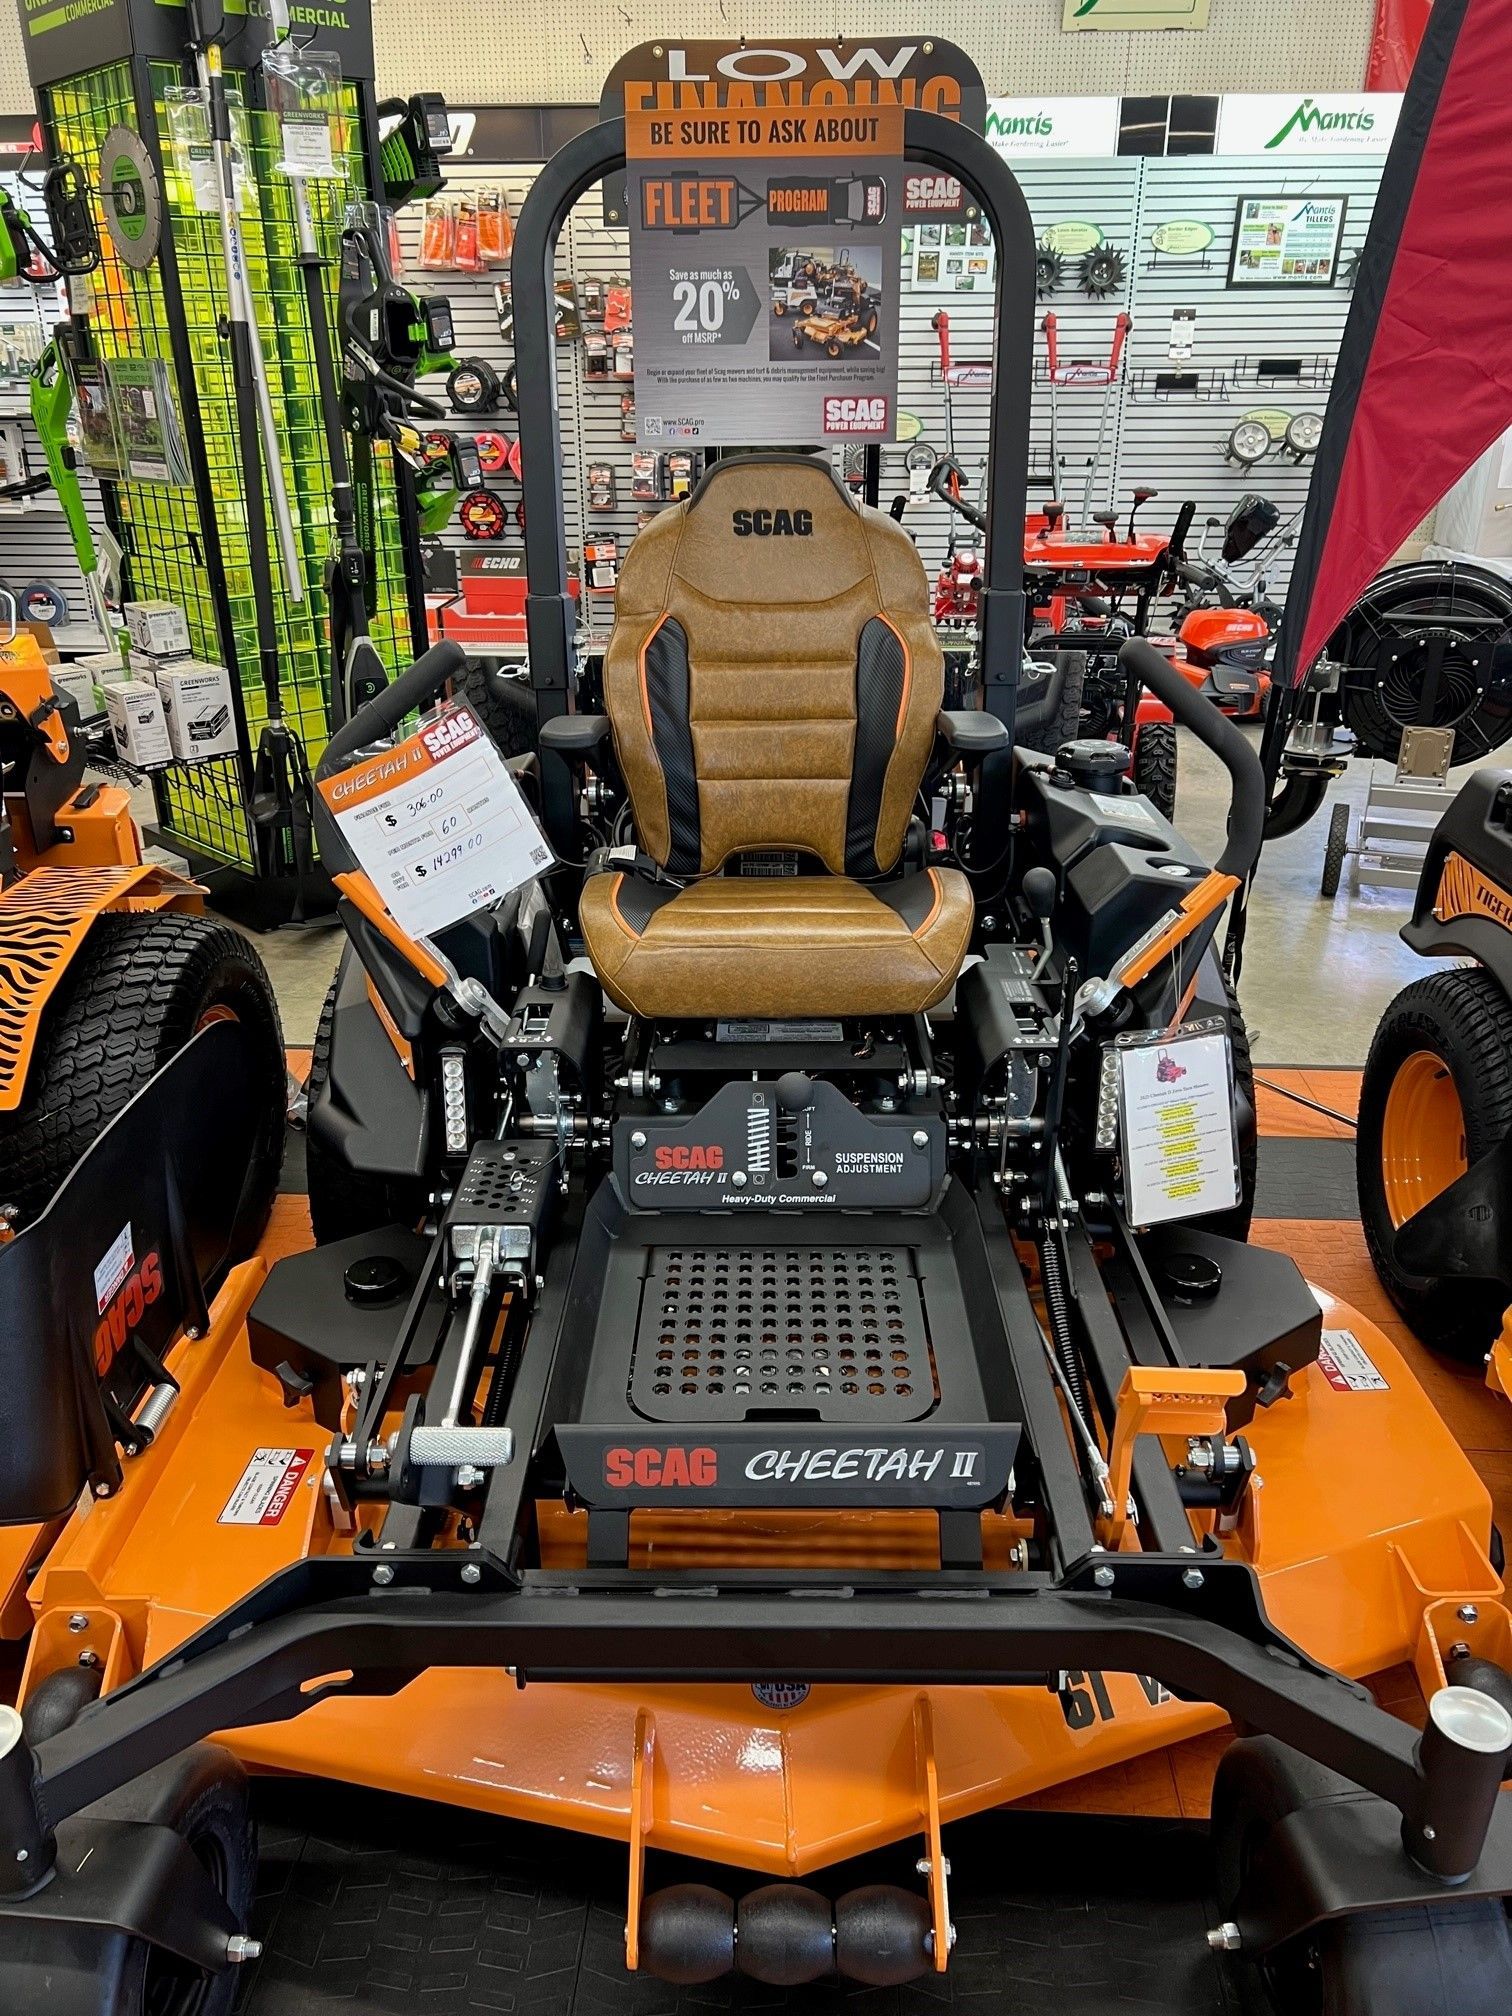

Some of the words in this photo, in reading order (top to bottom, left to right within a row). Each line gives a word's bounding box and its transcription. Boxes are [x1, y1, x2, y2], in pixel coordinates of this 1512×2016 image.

[669, 46, 918, 82] LOW
[283, 111, 325, 120] GREENWORKS
[1264, 99, 1375, 149] Mantis
[650, 121, 674, 145] BE
[680, 120, 731, 145] SURE
[736, 119, 761, 144] TO
[768, 118, 806, 143] ASK
[814, 117, 880, 143] ABOUT
[906, 177, 961, 200] SCAG
[645, 182, 735, 226] FLEET
[768, 189, 829, 213] PROGRAM
[867, 186, 877, 216] SCAG
[905, 199, 927, 209] POWER
[927, 199, 960, 208] EQUIPMENT
[1291, 202, 1336, 222] Mantis
[669, 269, 689, 281] Save
[689, 271, 699, 280] as
[700, 268, 722, 280] much
[723, 270, 733, 279] as
[672, 280, 740, 331] 20%
[682, 332, 694, 344] off
[646, 368, 660, 377] Begin
[714, 368, 726, 376] Scag
[826, 398, 886, 421] SCAG
[663, 417, 705, 427] www.SCAG.pro
[826, 421, 848, 431] POWER
[849, 420, 885, 431] EQUIPMENT
[361, 482, 371, 551] GREENWORKS
[733, 509, 812, 536] SCAG
[481, 557, 521, 569] ECHO
[179, 676, 220, 687] GREENWORKS
[124, 692, 156, 701] GREENWORKS
[423, 711, 474, 752] SCAG
[331, 754, 408, 801] CHEETAH
[412, 747, 424, 763] II
[385, 814, 398, 827] $
[442, 816, 457, 835] 60
[415, 865, 428, 878] $
[655, 1146, 724, 1170] SCAG
[835, 1152, 904, 1164] SUSPENSION
[634, 1171, 714, 1186] CHEETAH
[716, 1171, 728, 1184] II
[836, 1164, 903, 1174] ADJUSTMENT
[722, 1194, 778, 1205] Heavy-Duty
[779, 1193, 836, 1204] Commercial
[95, 1252, 162, 1377] SCAG
[605, 1447, 718, 1488] SCAG
[744, 1447, 944, 1482] CHEETAH
[949, 1451, 979, 1479] II
[265, 1471, 299, 1518] DANGER
